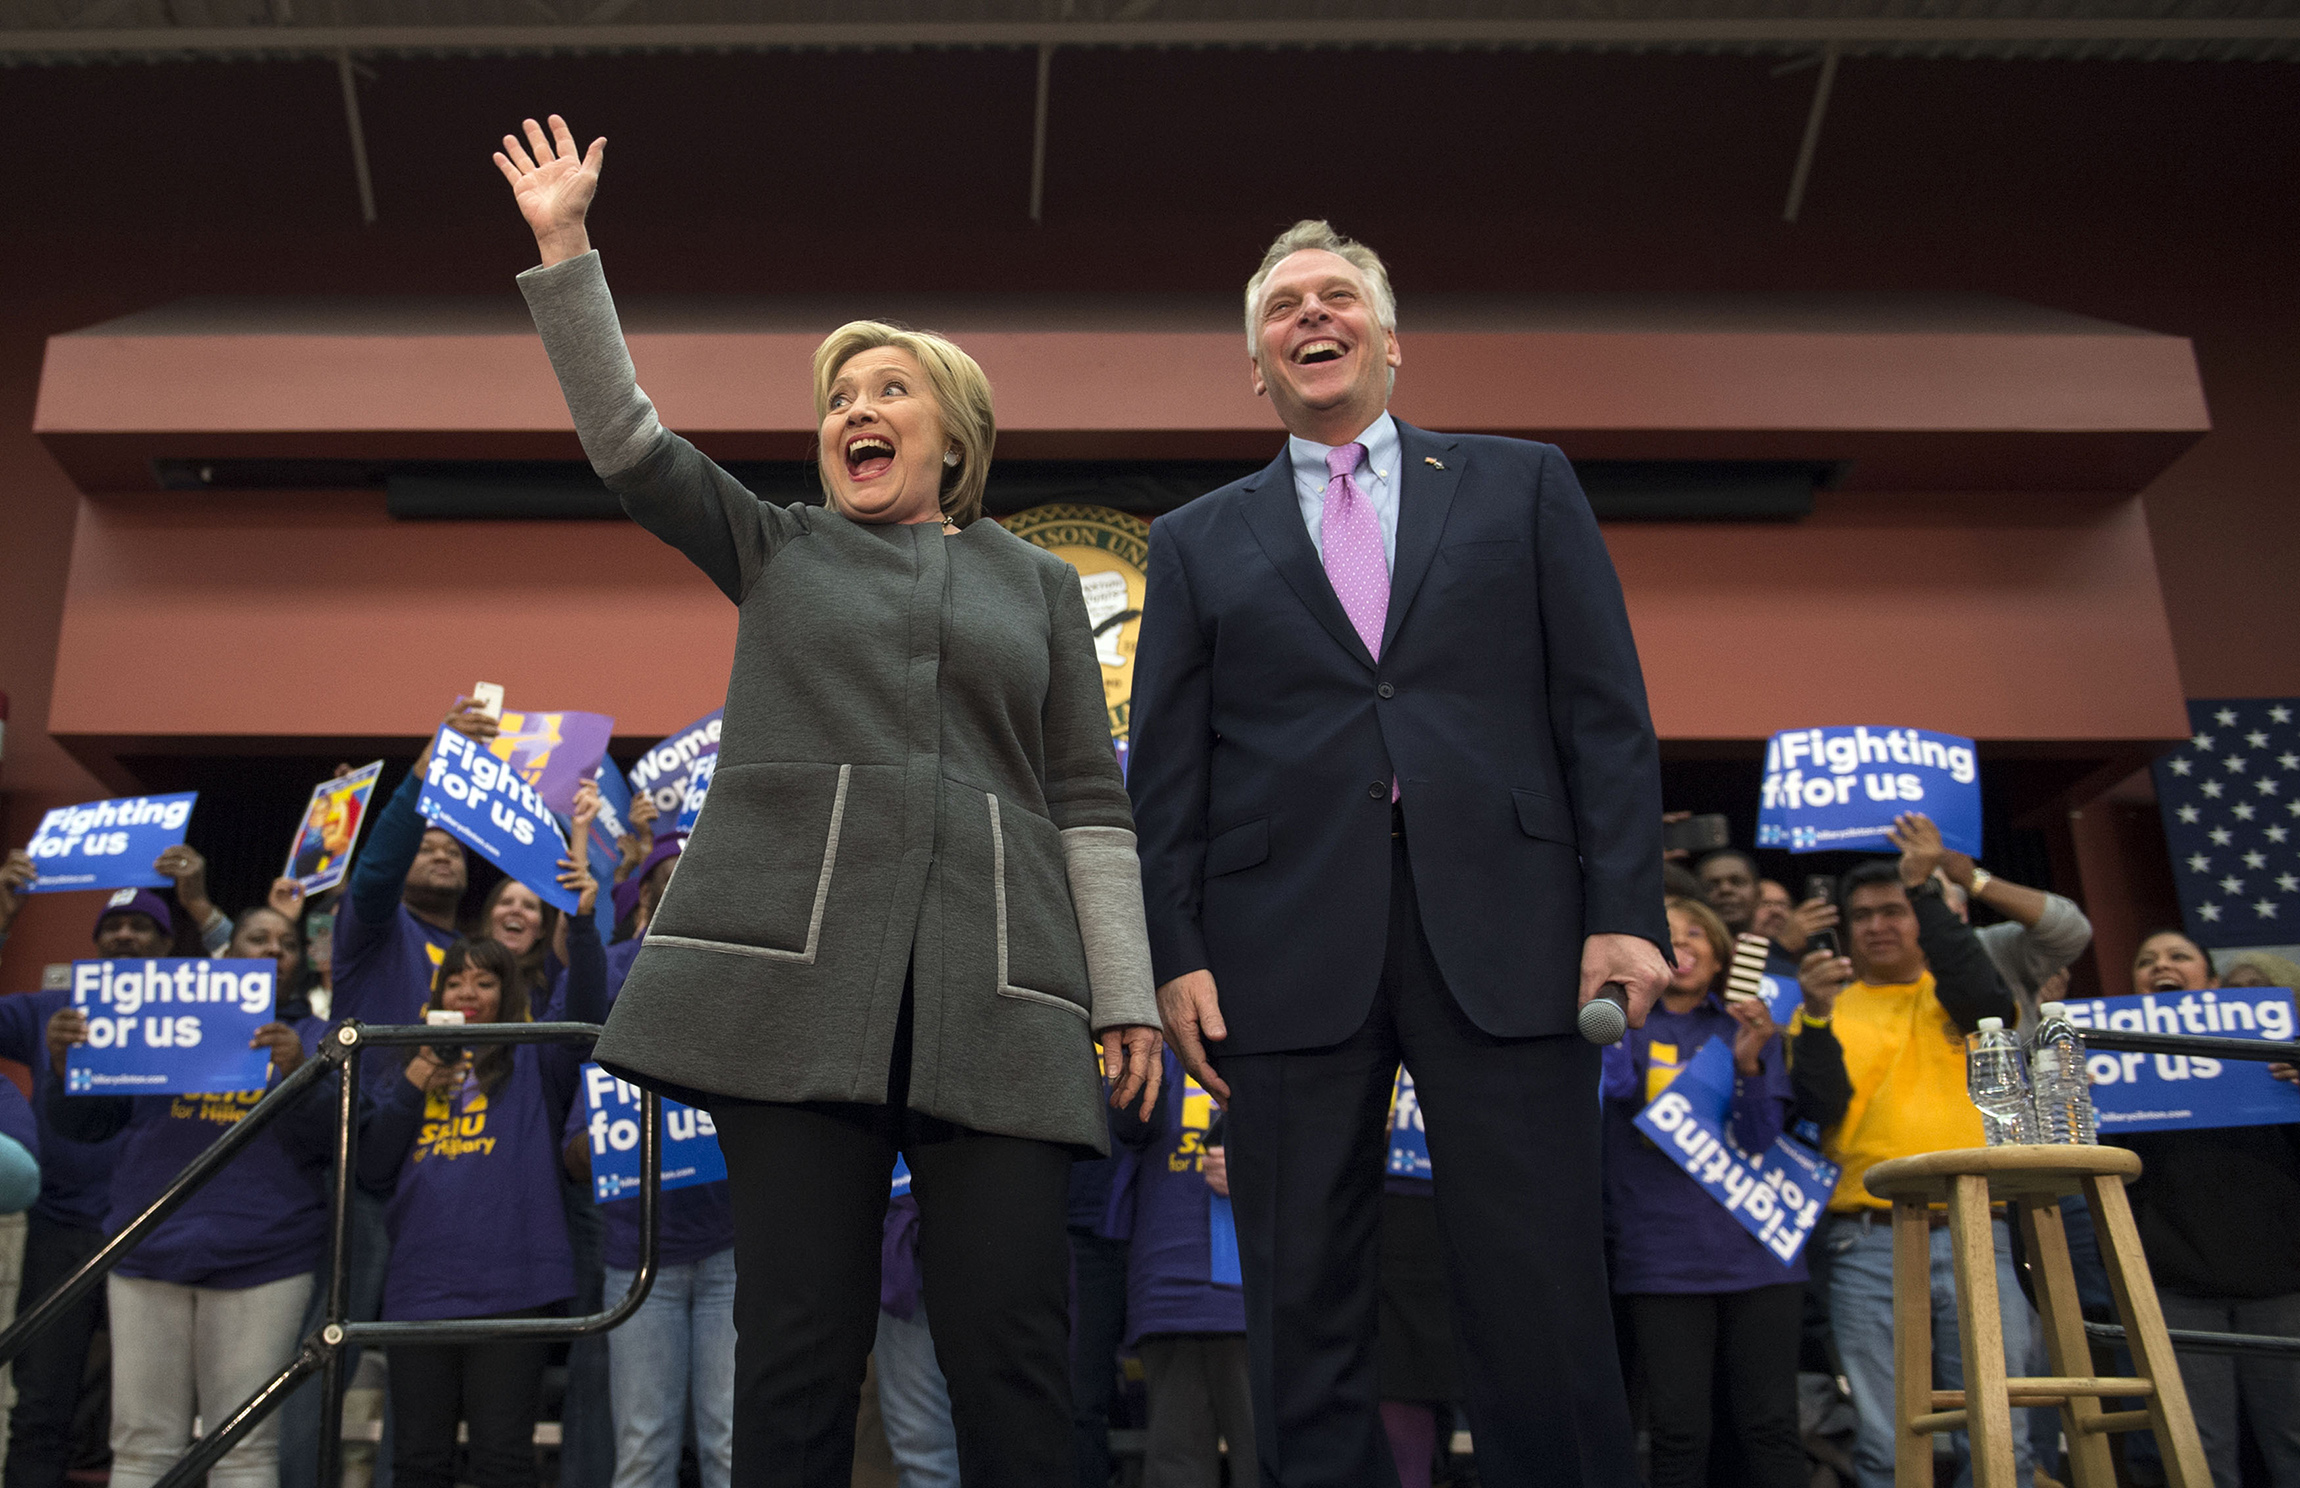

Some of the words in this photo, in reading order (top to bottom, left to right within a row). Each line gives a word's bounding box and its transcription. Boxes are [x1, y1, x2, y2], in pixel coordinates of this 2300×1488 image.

[1780, 726, 1976, 784] Fighting
[428, 757, 489, 810] for
[490, 800, 536, 846] us
[643, 775, 689, 812] or
[681, 785, 707, 814] fo
[1784, 769, 1858, 810] for
[1863, 773, 1925, 802] us
[39, 797, 192, 836] Fighting
[26, 833, 83, 859] for
[83, 830, 130, 857] us
[74, 959, 272, 1015] Fighting
[144, 1015, 203, 1048] us
[2064, 991, 2294, 1041] Fighting
[2085, 1052, 2146, 1086] or
[2154, 1054, 2223, 1082] us
[588, 1110, 640, 1155] fo
[666, 1108, 718, 1141] us
[1646, 1092, 1805, 1261] Fighting
[1762, 1167, 1820, 1230] for
